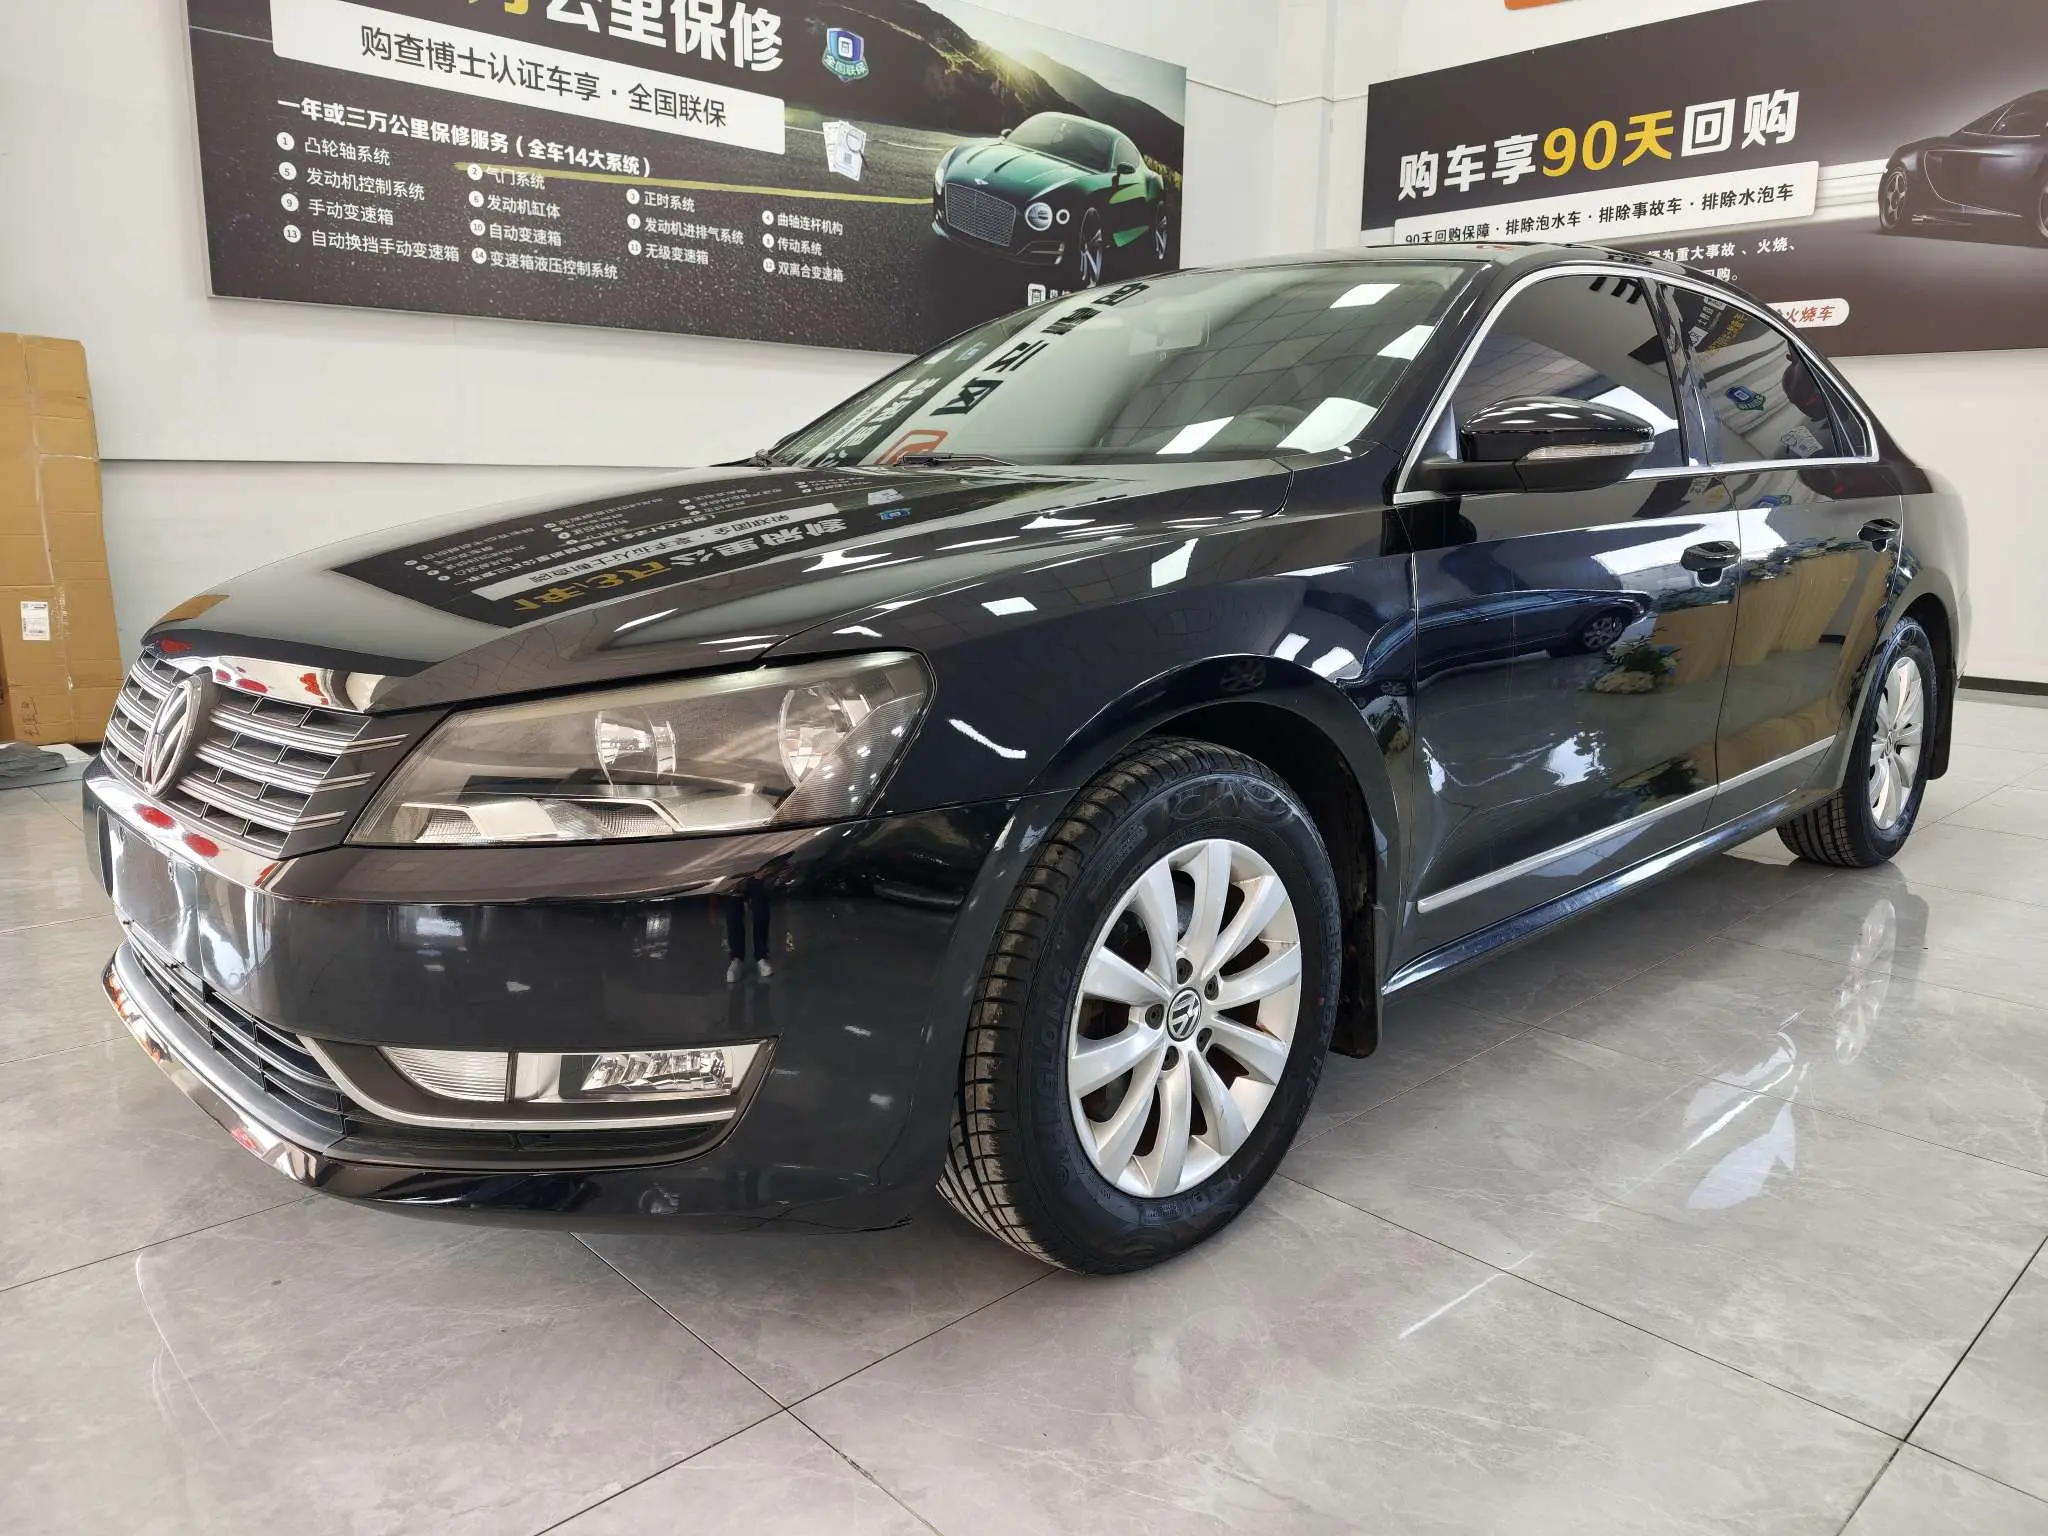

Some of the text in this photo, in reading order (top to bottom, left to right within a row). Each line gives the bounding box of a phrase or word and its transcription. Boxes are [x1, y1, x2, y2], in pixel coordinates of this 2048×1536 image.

[304, 136, 391, 167] 凸轮轴系统
[1398, 88, 1800, 202] 购车享90天回购
[306, 167, 426, 201] 发动机控制系统
[308, 198, 395, 226] 手动变速箱
[487, 194, 561, 220] 发动机缸体
[643, 190, 696, 213] 正时系统
[488, 222, 563, 248] 自动变速箱
[643, 217, 746, 247] 发动机进排气系统
[777, 212, 844, 237] 曲轴连杆机构
[311, 229, 461, 263] 自动换挡手动变速箱
[644, 242, 710, 266] 无级变速箱
[777, 236, 823, 257] 传动系统
[489, 250, 619, 281] 变速箱液压控制系统
[777, 261, 845, 284] 双离合变速箱
